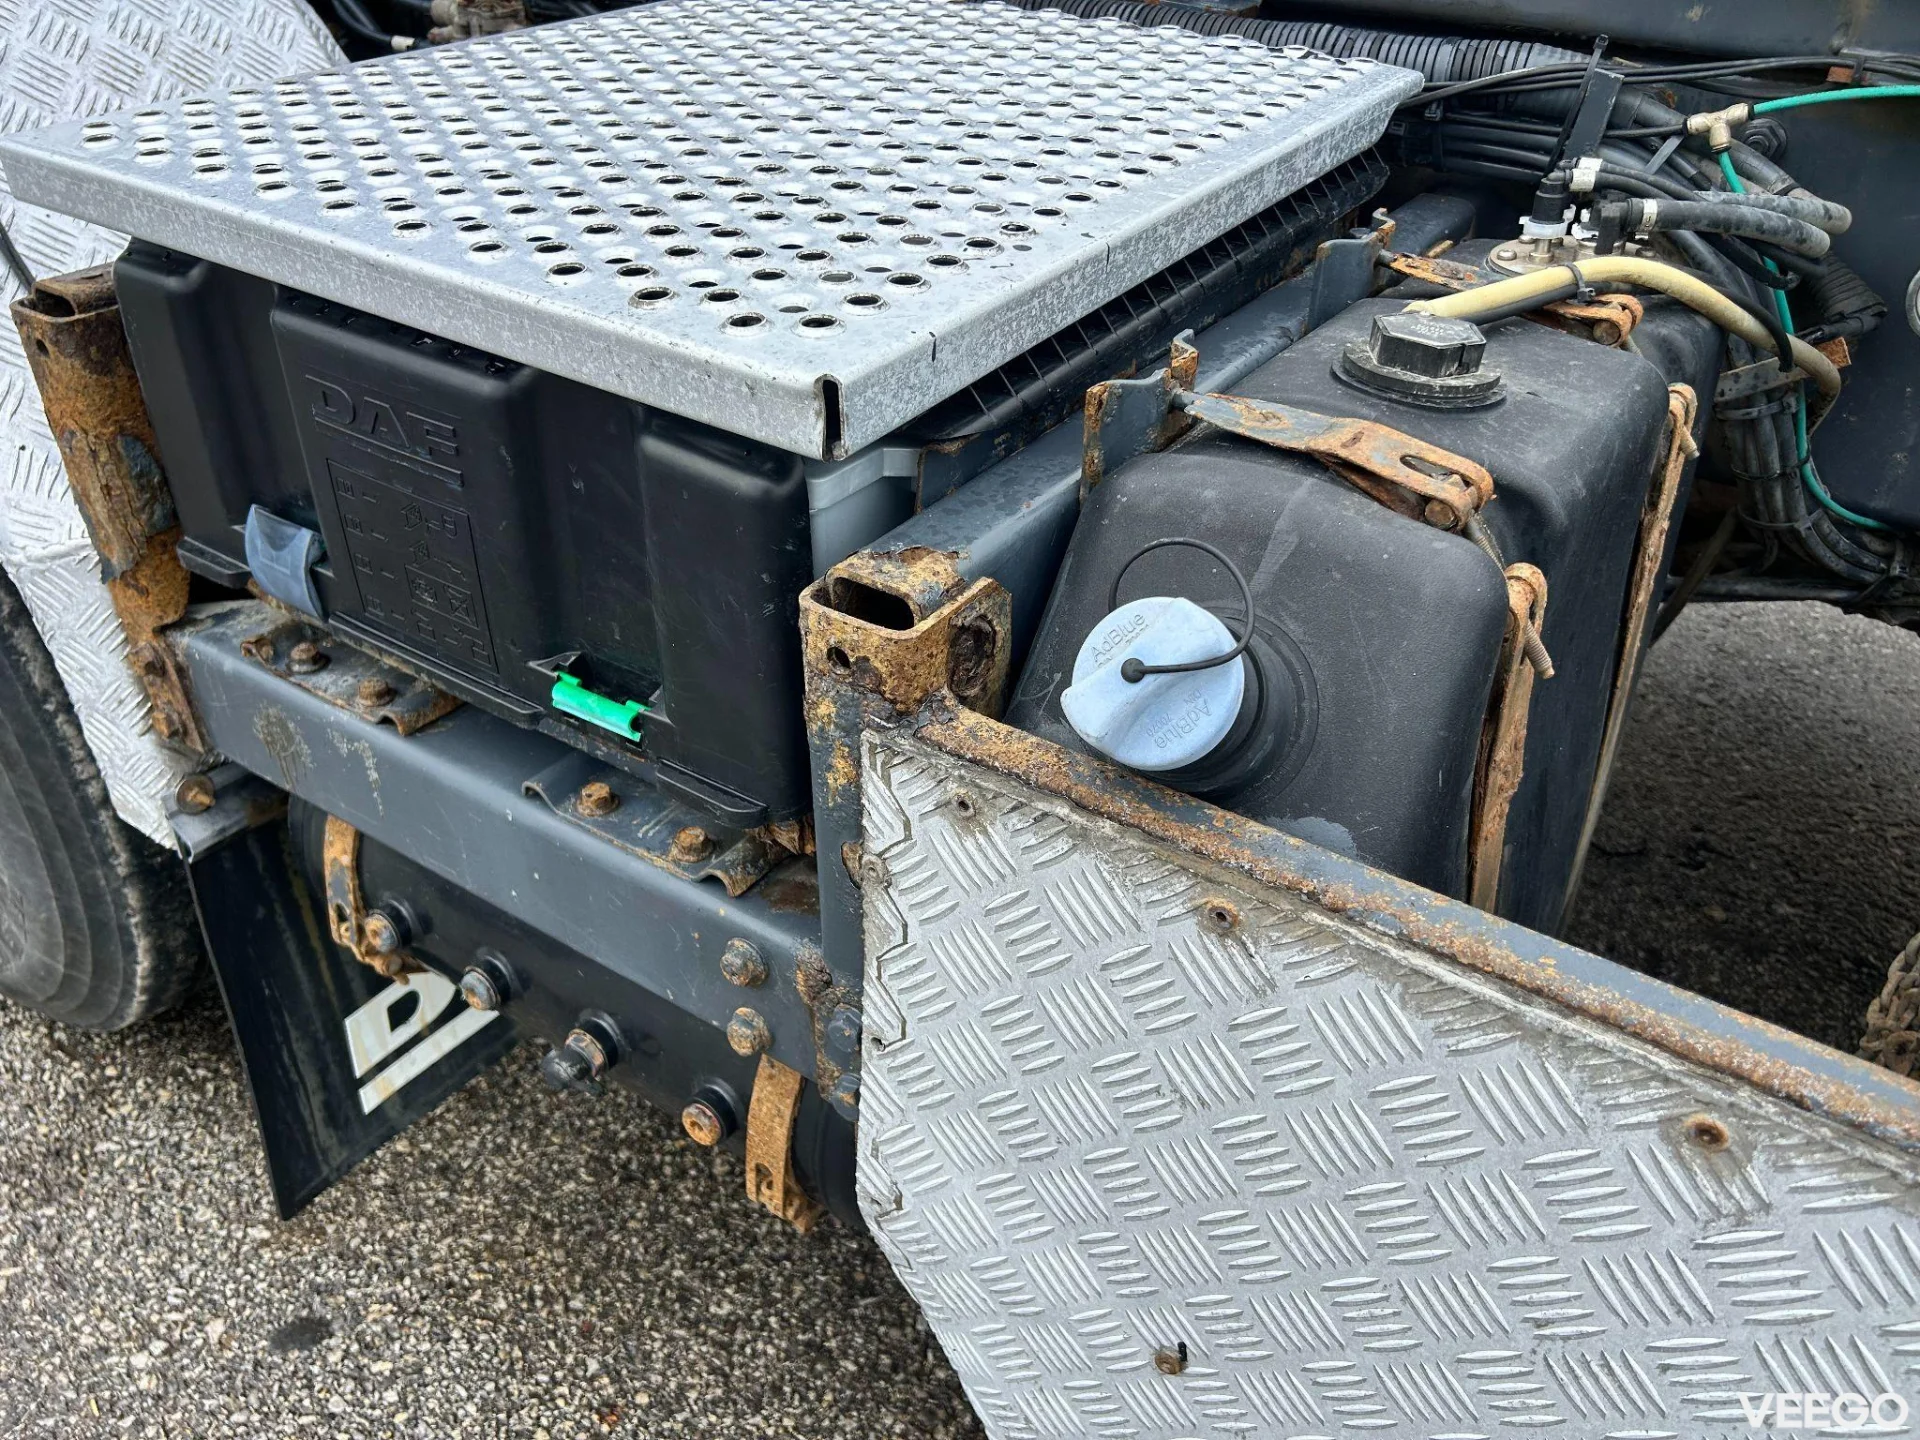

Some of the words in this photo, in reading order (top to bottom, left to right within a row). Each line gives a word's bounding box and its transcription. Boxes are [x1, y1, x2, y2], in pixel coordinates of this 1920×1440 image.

[305, 374, 458, 456] DAF
[1090, 613, 1146, 663] AdBlue
[1154, 698, 1213, 750] AdBlue
